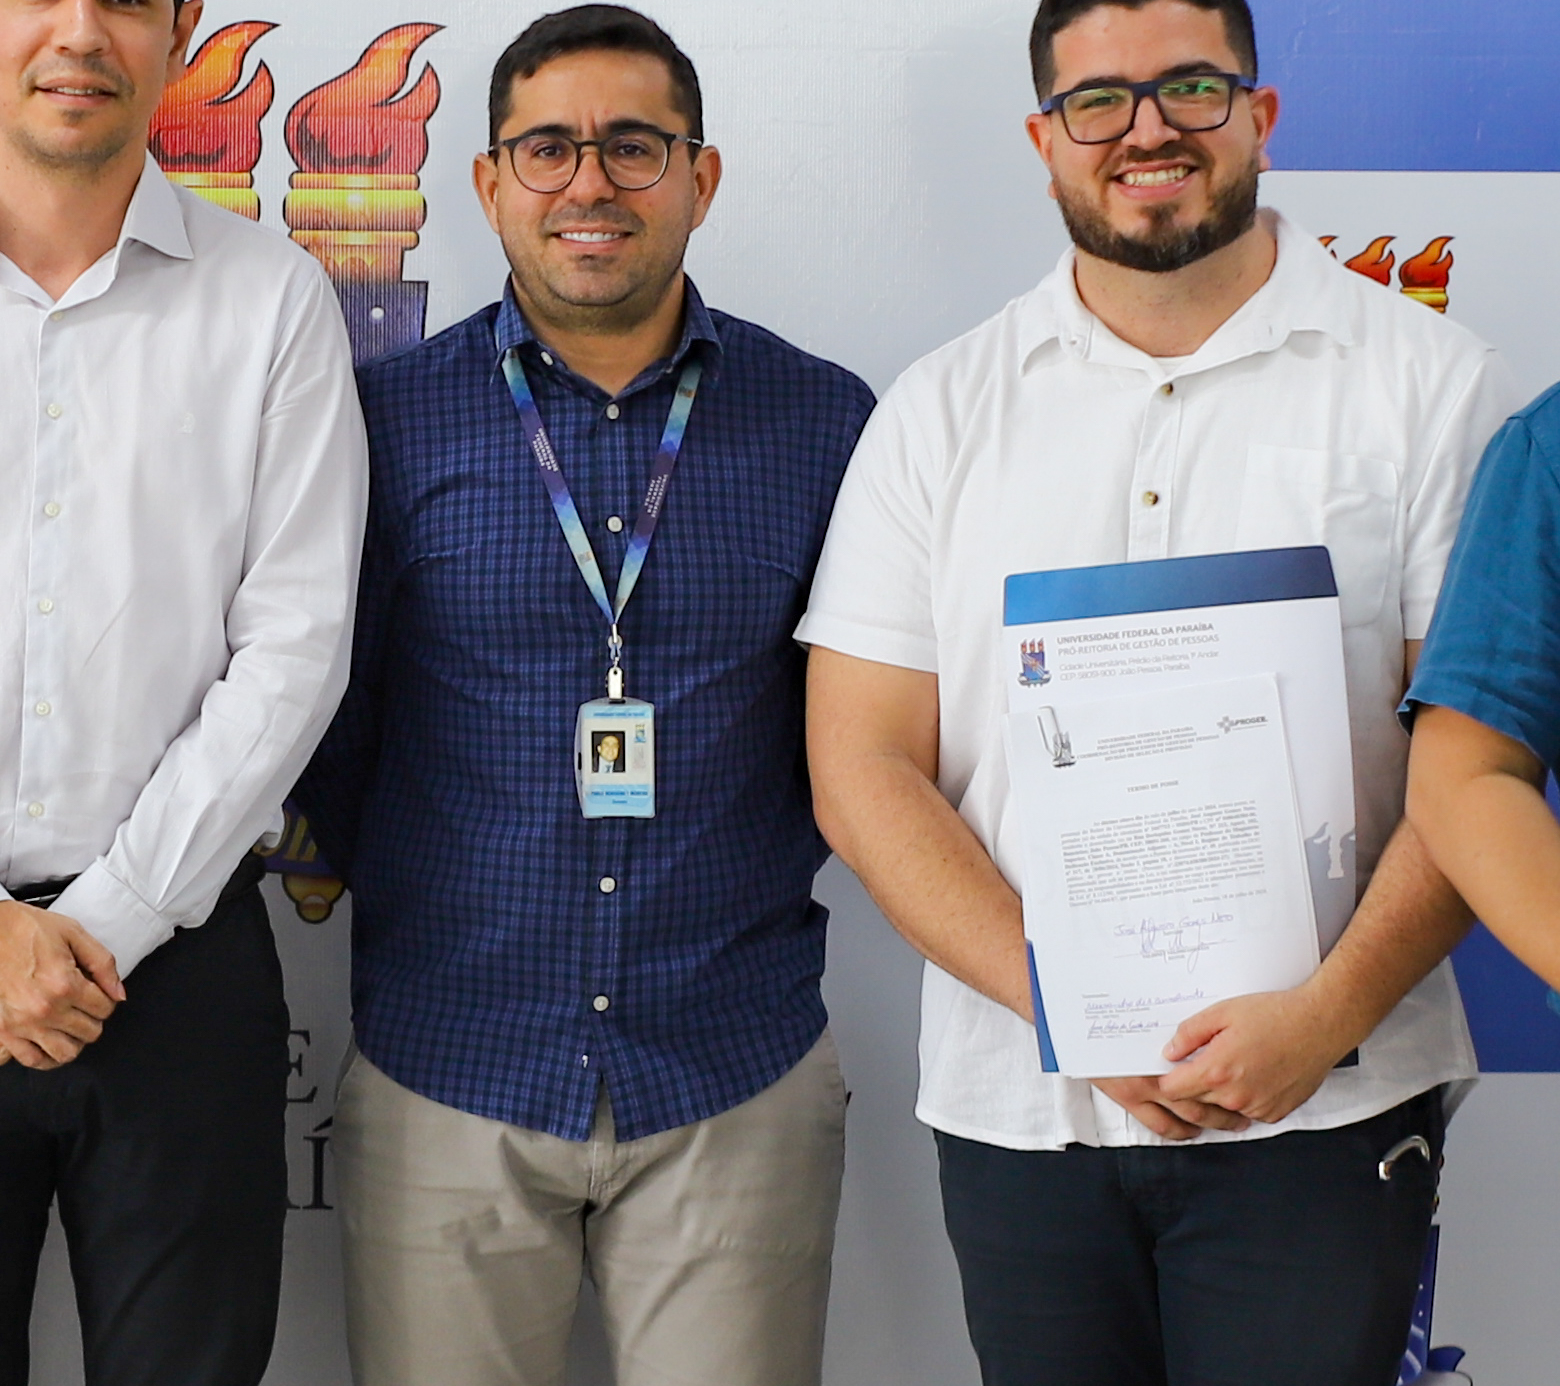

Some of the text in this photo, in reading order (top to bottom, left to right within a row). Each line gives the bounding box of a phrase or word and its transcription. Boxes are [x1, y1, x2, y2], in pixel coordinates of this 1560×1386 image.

[1057, 622, 1215, 645] UNIVERSIDADE FEDERAL DA PARAÍBA
[1120, 641, 1131, 651] DE
[1132, 637, 1167, 650] GESTÃO
[1168, 637, 1179, 646] DE
[1181, 633, 1220, 645] PESSOAS
